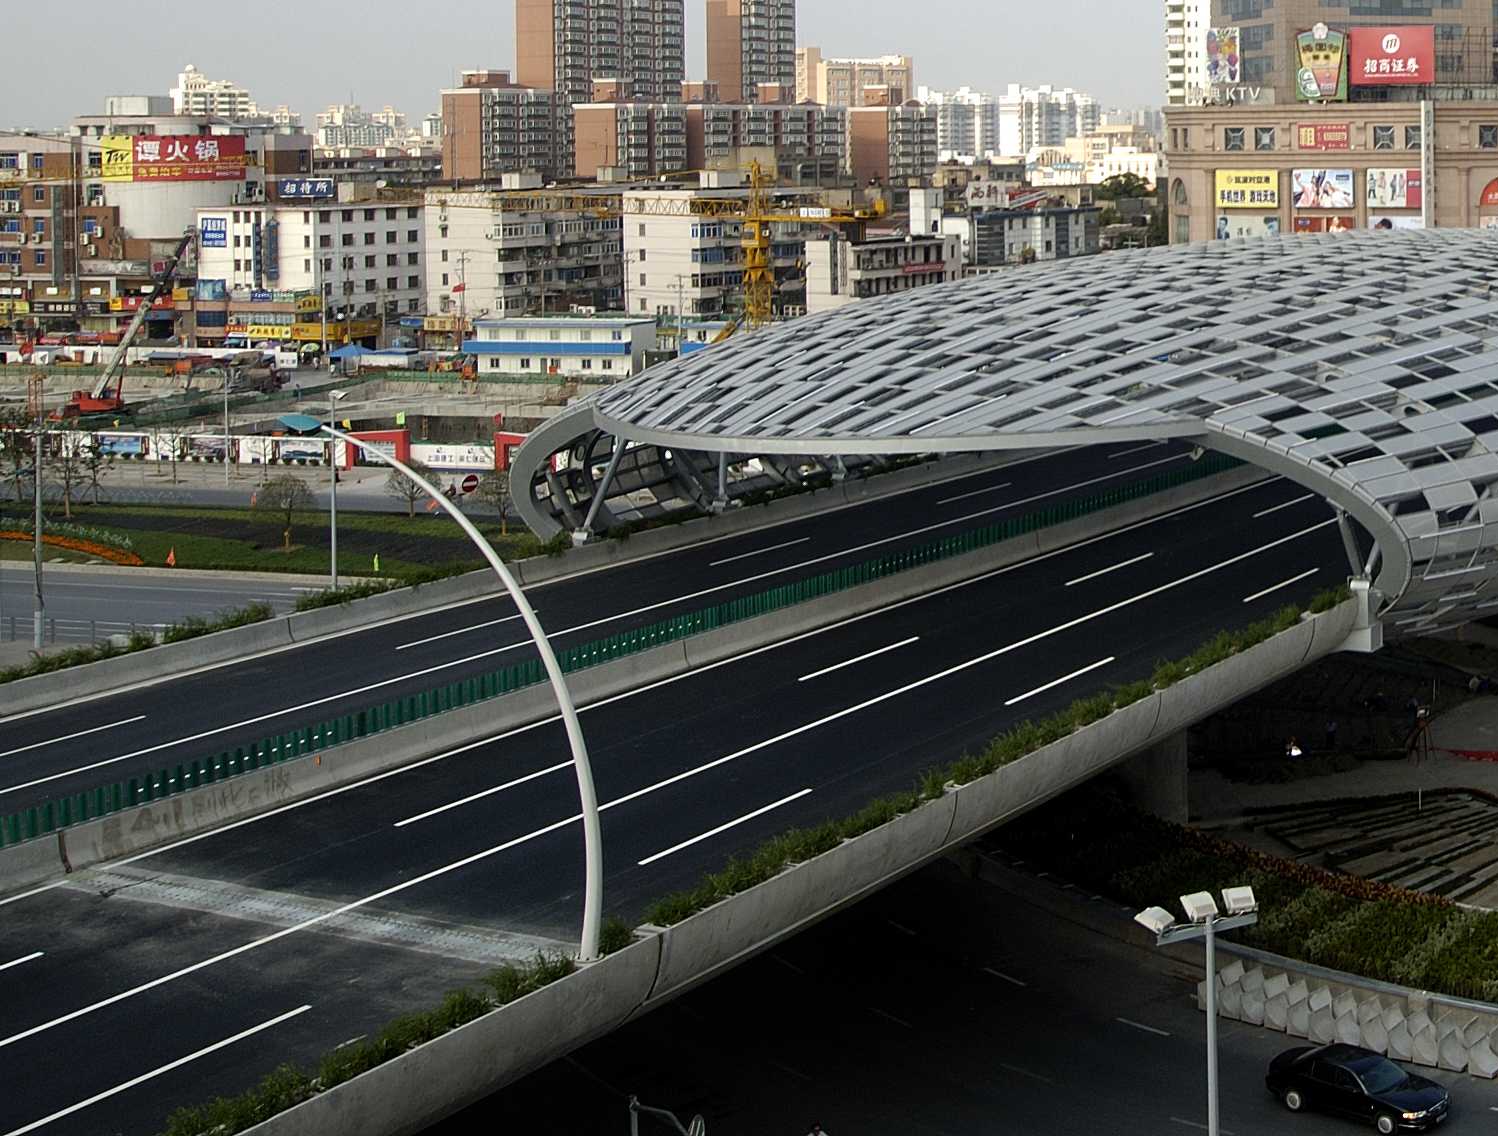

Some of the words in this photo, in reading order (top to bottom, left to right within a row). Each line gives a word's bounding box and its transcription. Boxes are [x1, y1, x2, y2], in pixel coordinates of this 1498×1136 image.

[1364, 57, 1418, 73] 招商证券
[1226, 87, 1260, 100] KTV
